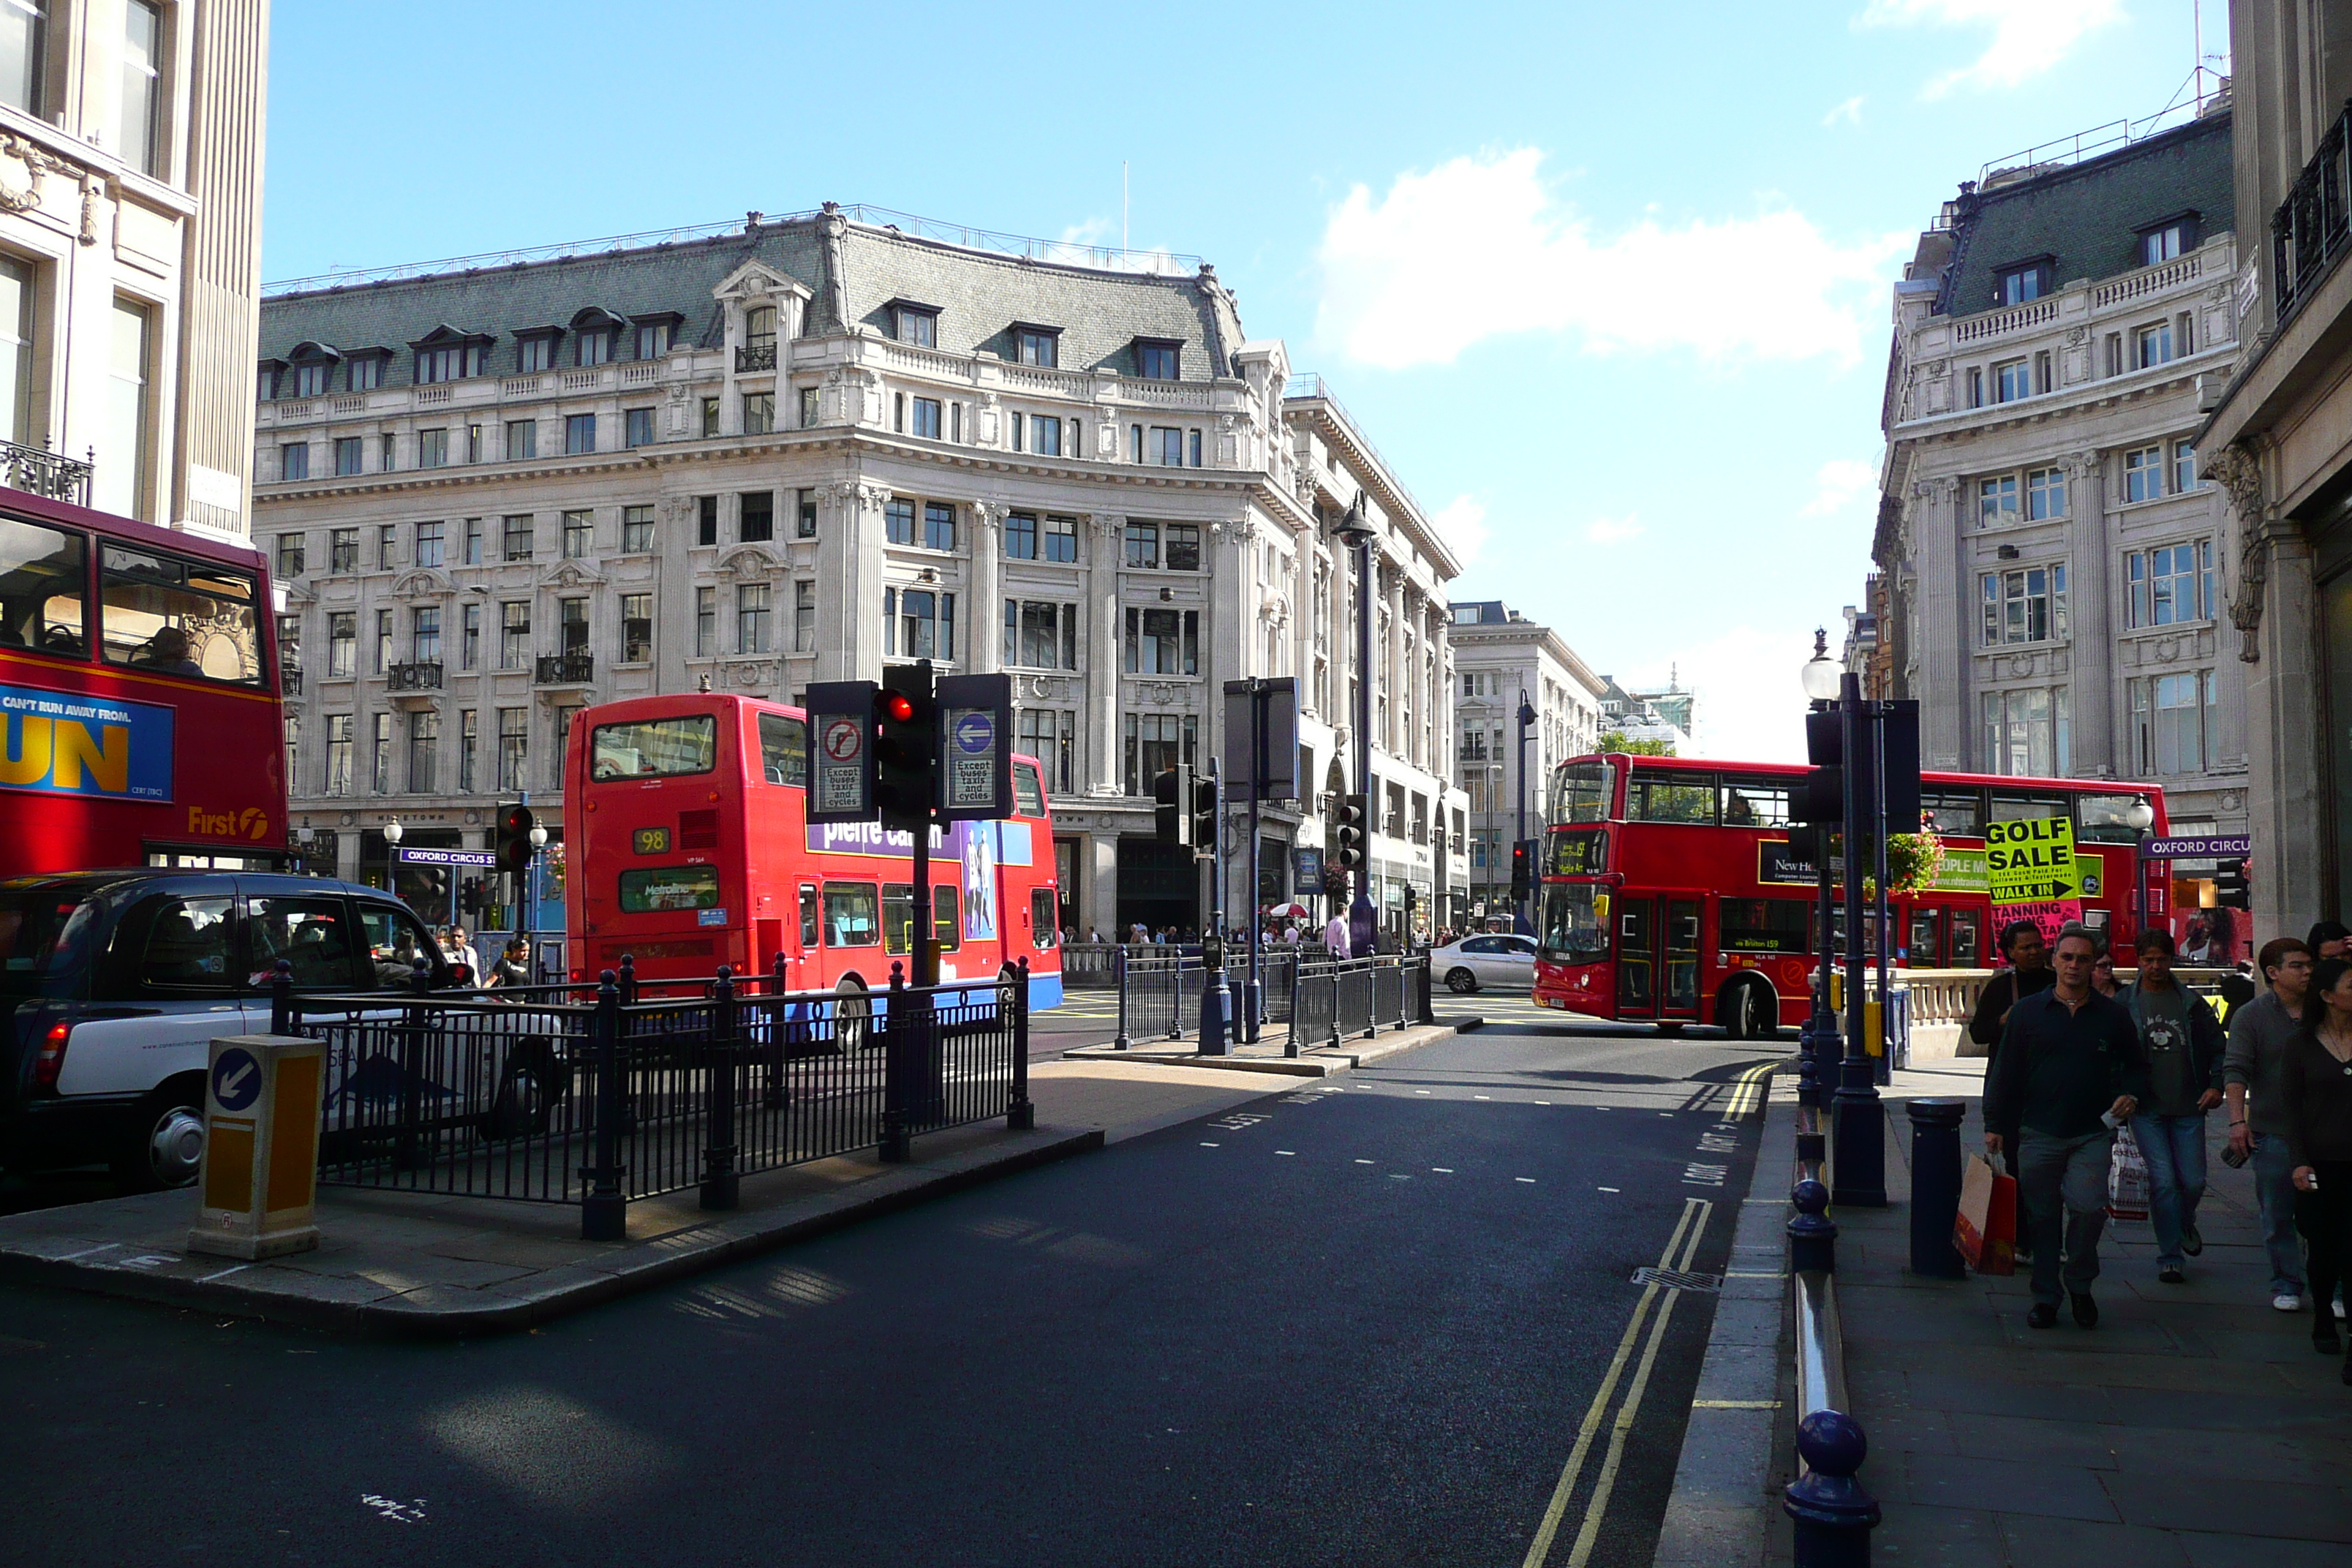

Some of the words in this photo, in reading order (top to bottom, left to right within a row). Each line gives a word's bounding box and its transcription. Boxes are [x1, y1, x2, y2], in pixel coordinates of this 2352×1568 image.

[3, 696, 37, 710] CAN'T
[38, 701, 64, 714] RUN
[64, 704, 97, 719] AWAY
[97, 708, 132, 723] FROM.
[957, 761, 990, 771] Except
[827, 769, 858, 777] Except
[962, 777, 985, 785] taxis
[834, 791, 851, 799] and
[965, 785, 982, 793] and
[829, 798, 856, 806] cycles
[959, 792, 988, 800] cycles
[188, 806, 236, 835] First
[823, 822, 883, 849] pierre
[1986, 818, 2067, 844] GOLF
[642, 832, 663, 850] 98
[2152, 840, 2206, 853] OXFORD
[407, 851, 448, 862] OXFORD
[450, 853, 485, 864] CIRCUS
[1988, 845, 2070, 870] SALE
[1775, 859, 1798, 871] New
[1937, 859, 1970, 872] EOPLE
[1992, 885, 2034, 899] WALK
[2038, 883, 2054, 896] IN
[1991, 902, 2061, 919] TANNING
[1993, 916, 2046, 929] WANG
[1767, 940, 1779, 948] 159
